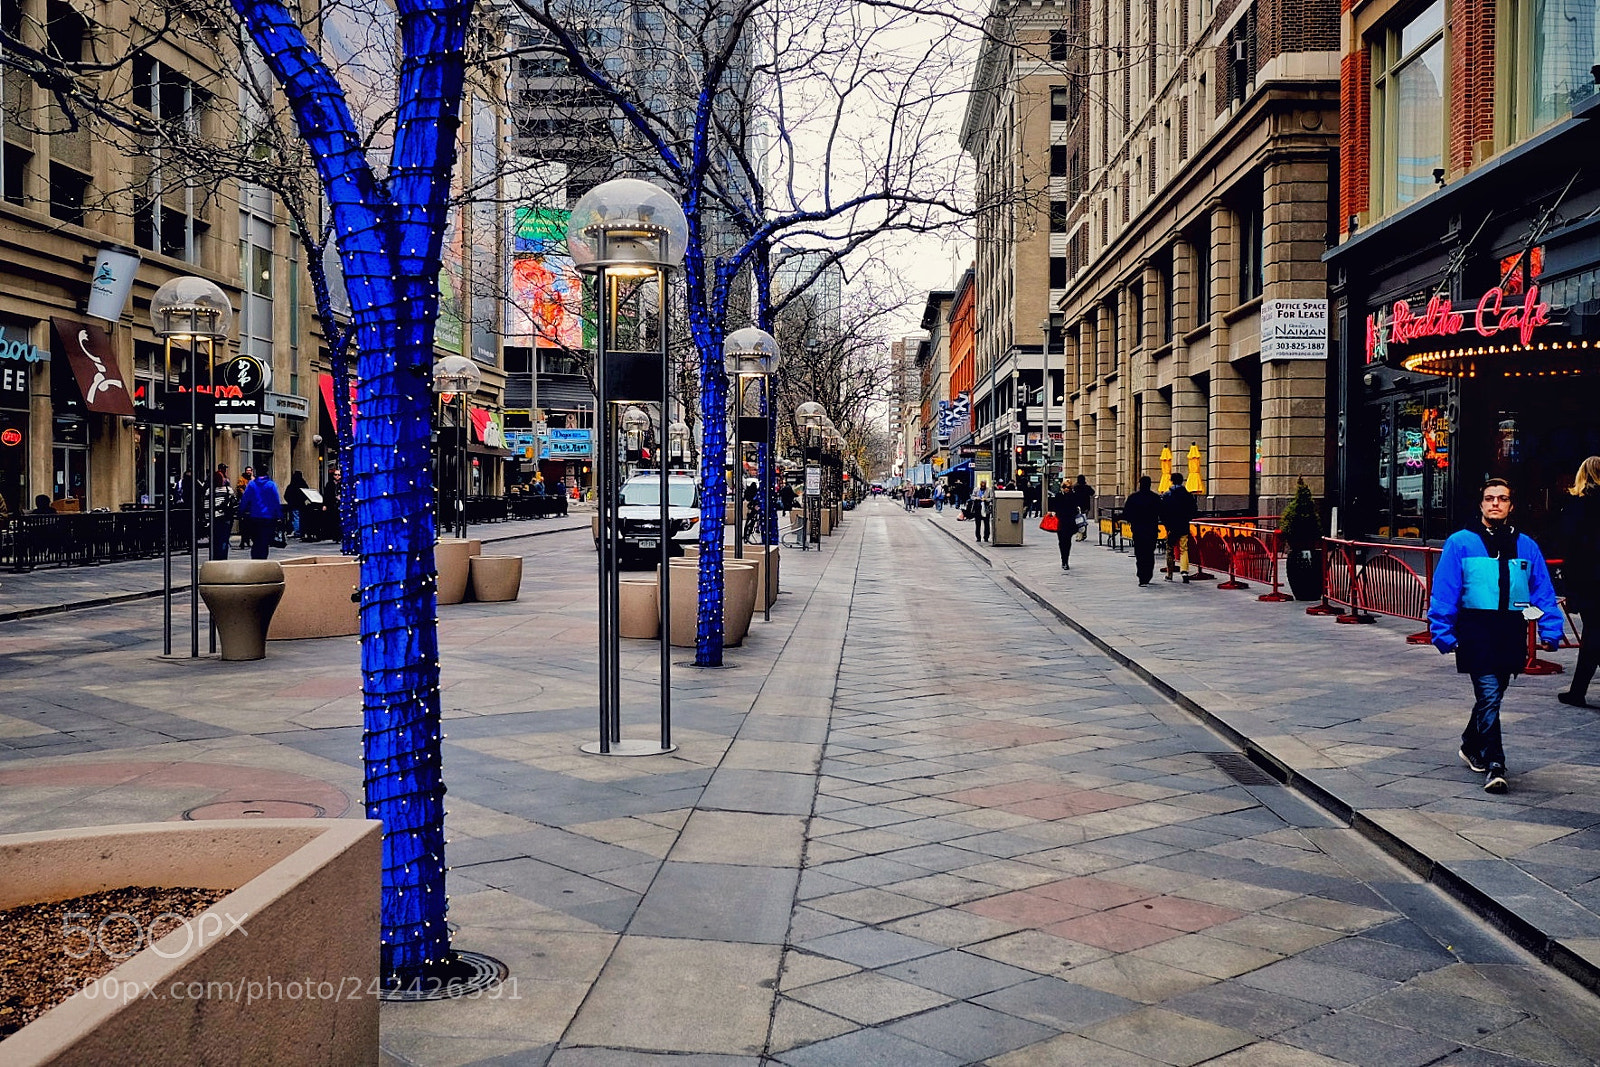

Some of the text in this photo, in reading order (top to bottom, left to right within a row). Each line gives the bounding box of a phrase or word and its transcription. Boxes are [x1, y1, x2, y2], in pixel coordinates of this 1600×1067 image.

[1277, 310, 1324, 318] FOR LEASE
[1392, 296, 1464, 344] Rialto
[1475, 285, 1552, 347] Cafe
[1275, 323, 1325, 336] NAIMAN
